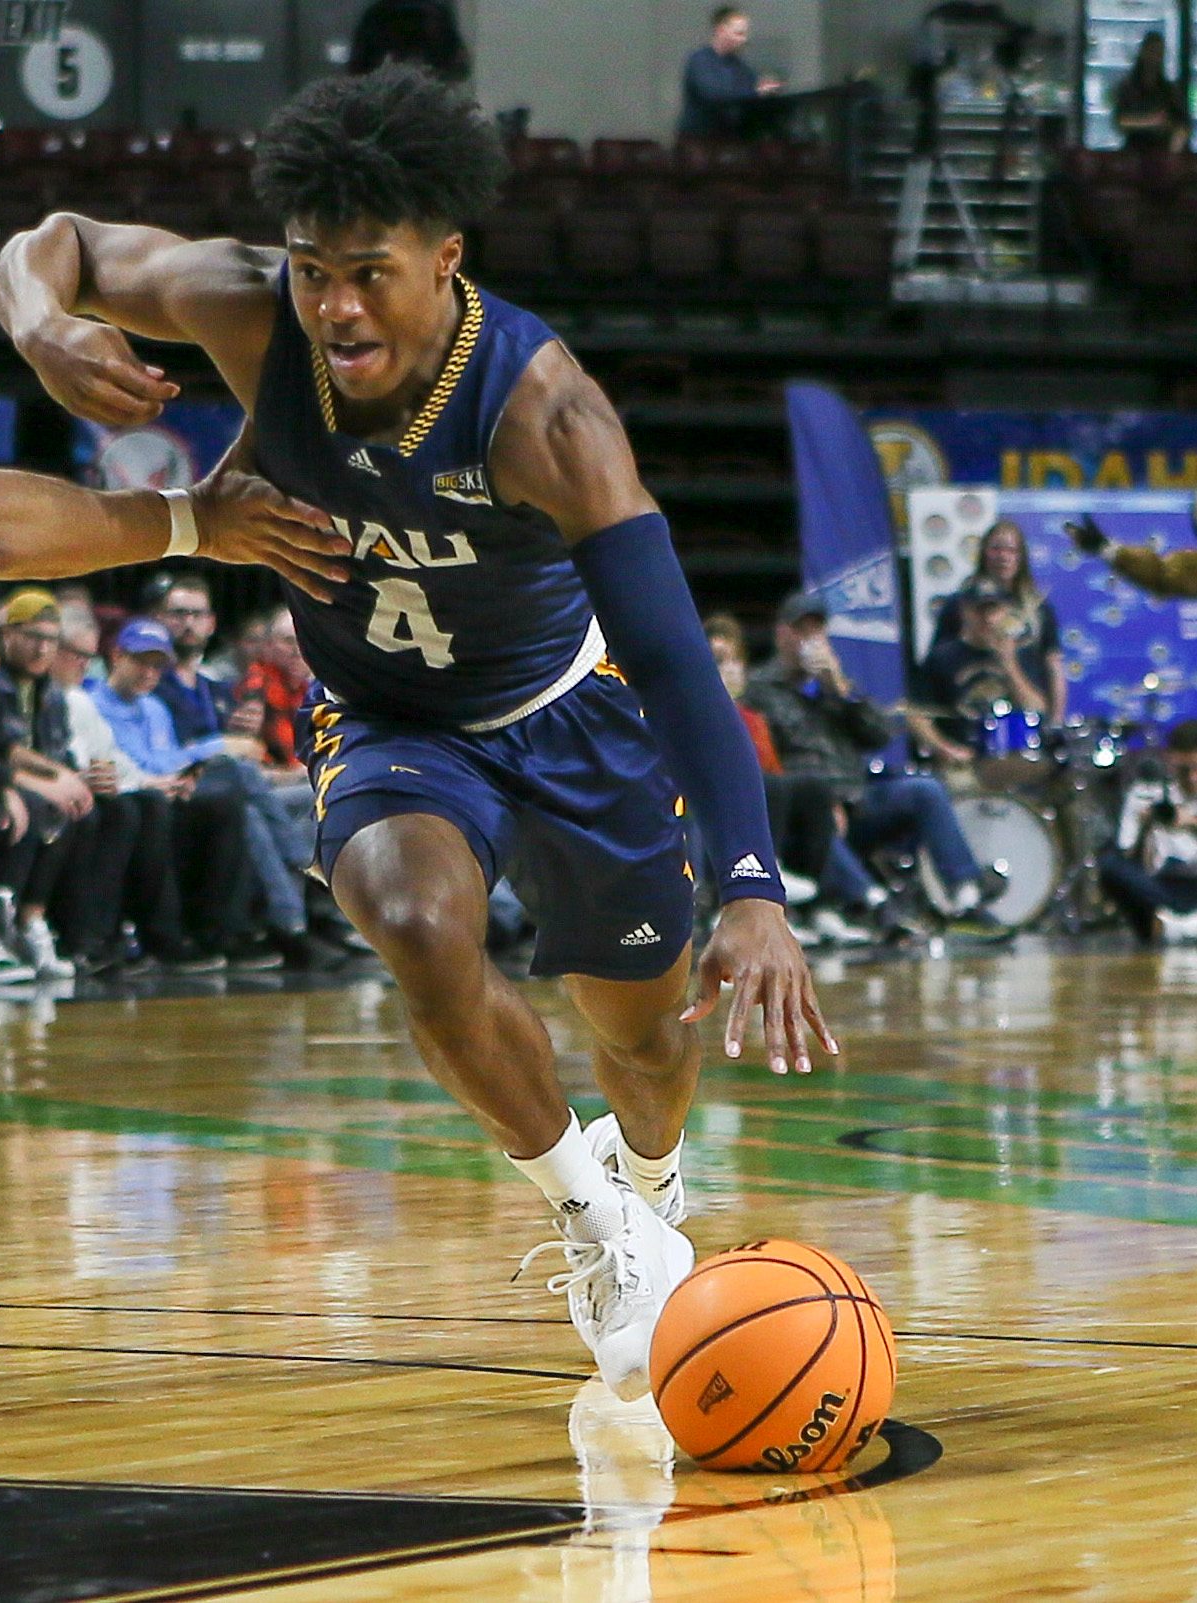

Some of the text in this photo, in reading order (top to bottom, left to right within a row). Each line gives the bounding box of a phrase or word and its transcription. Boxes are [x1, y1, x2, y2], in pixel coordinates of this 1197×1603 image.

[57, 46, 80, 99] 5
[332, 515, 478, 570] AU
[366, 577, 455, 669] 4
[620, 935, 661, 946] adidas
